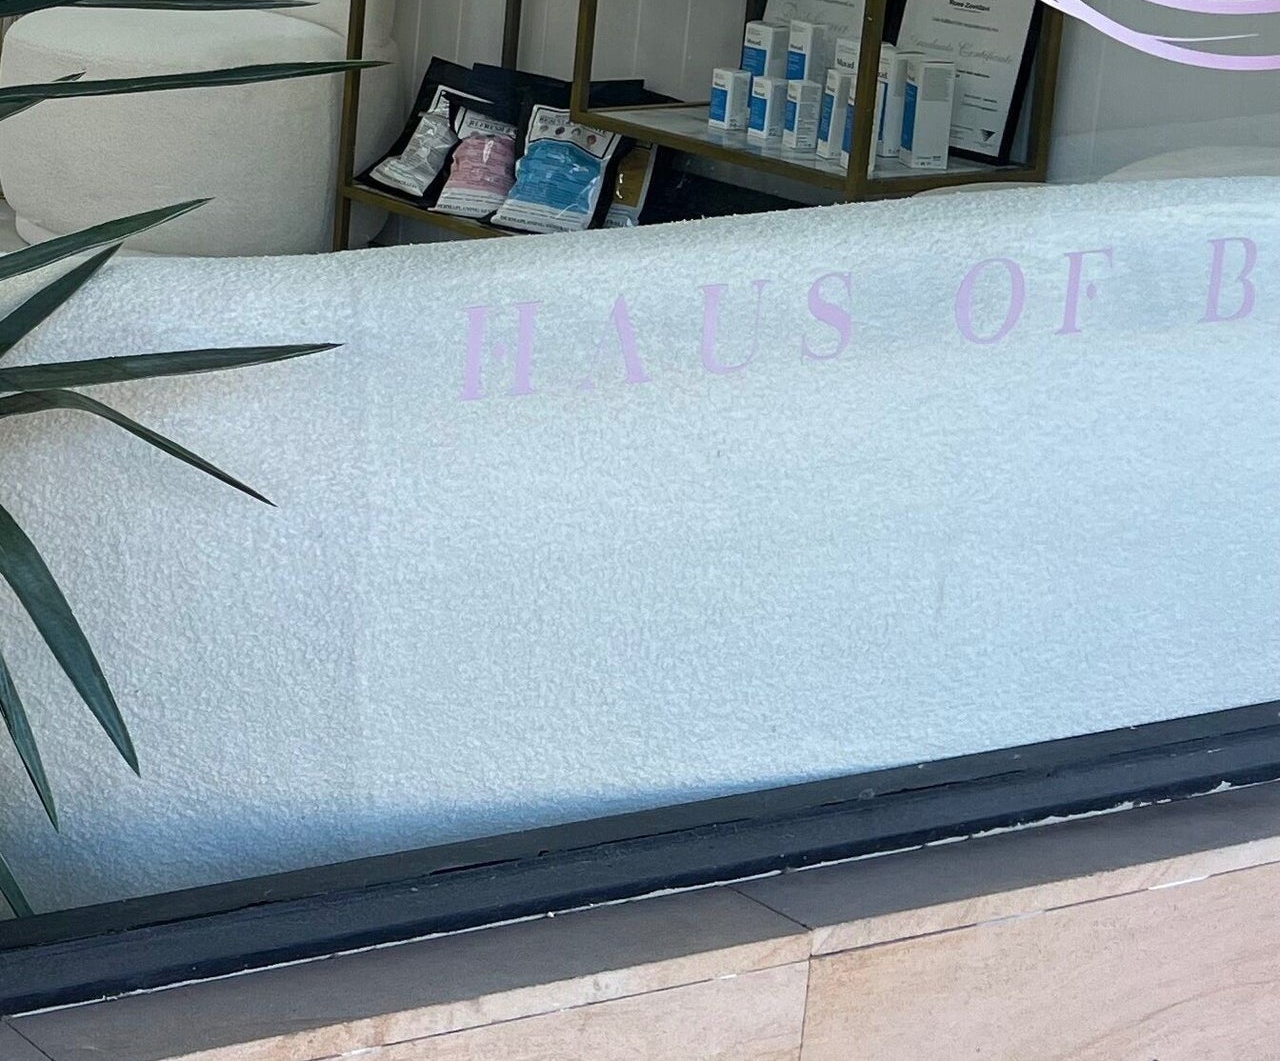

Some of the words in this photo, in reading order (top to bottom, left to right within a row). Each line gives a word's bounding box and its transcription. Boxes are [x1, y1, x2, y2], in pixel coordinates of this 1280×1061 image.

[458, 272, 854, 402] HAUS
[954, 247, 1114, 345] OF
[1197, 236, 1259, 324] B
